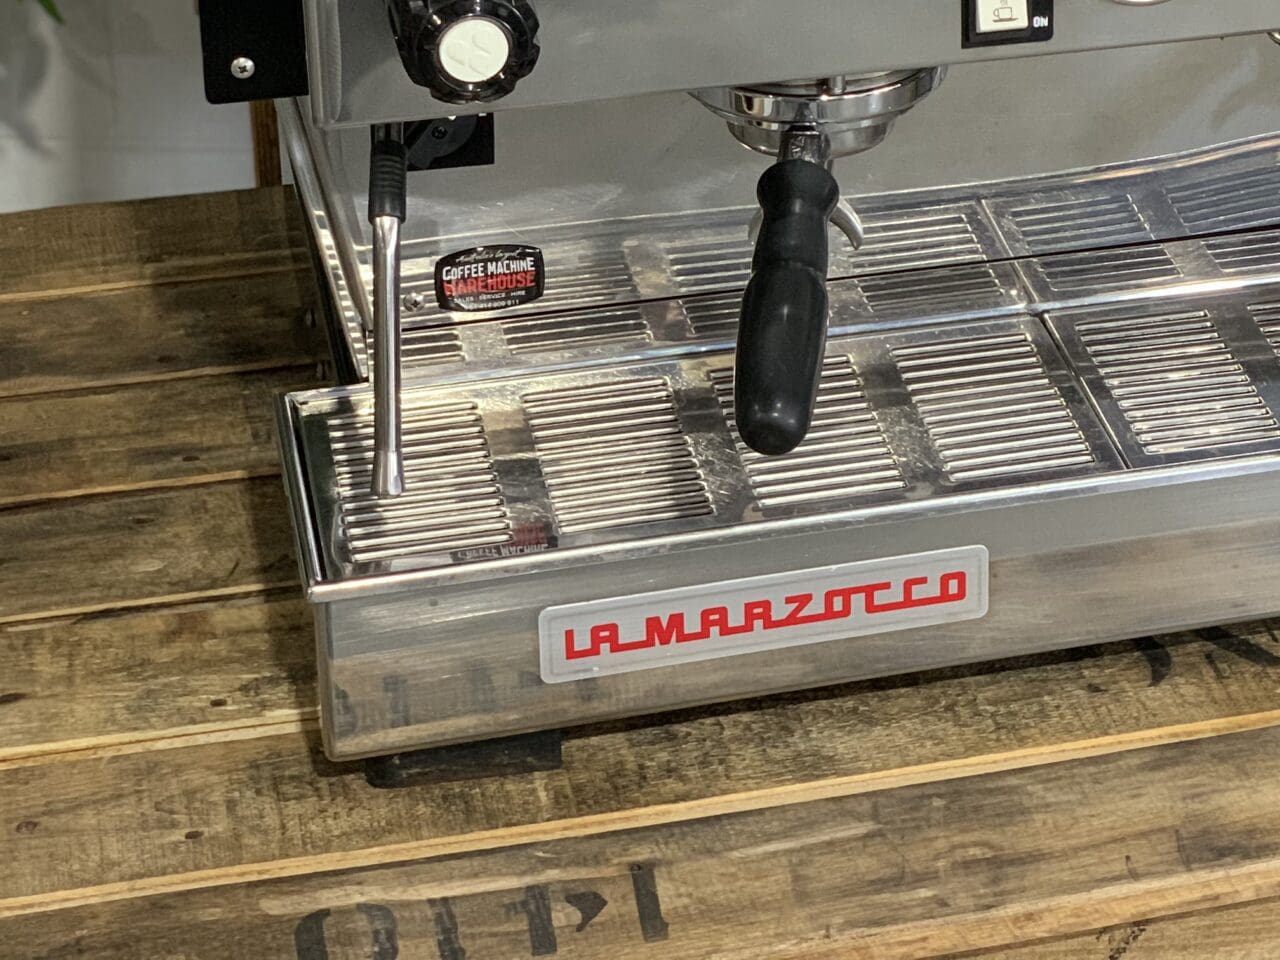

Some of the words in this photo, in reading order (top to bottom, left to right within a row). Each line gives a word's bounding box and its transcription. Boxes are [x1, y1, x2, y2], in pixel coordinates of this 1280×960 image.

[1033, 15, 1049, 28] ON
[442, 262, 485, 281] COFFEE
[487, 256, 536, 275] MACHINE
[442, 271, 537, 297] WAREHOUSE
[645, 570, 967, 646] MARZOCCO
